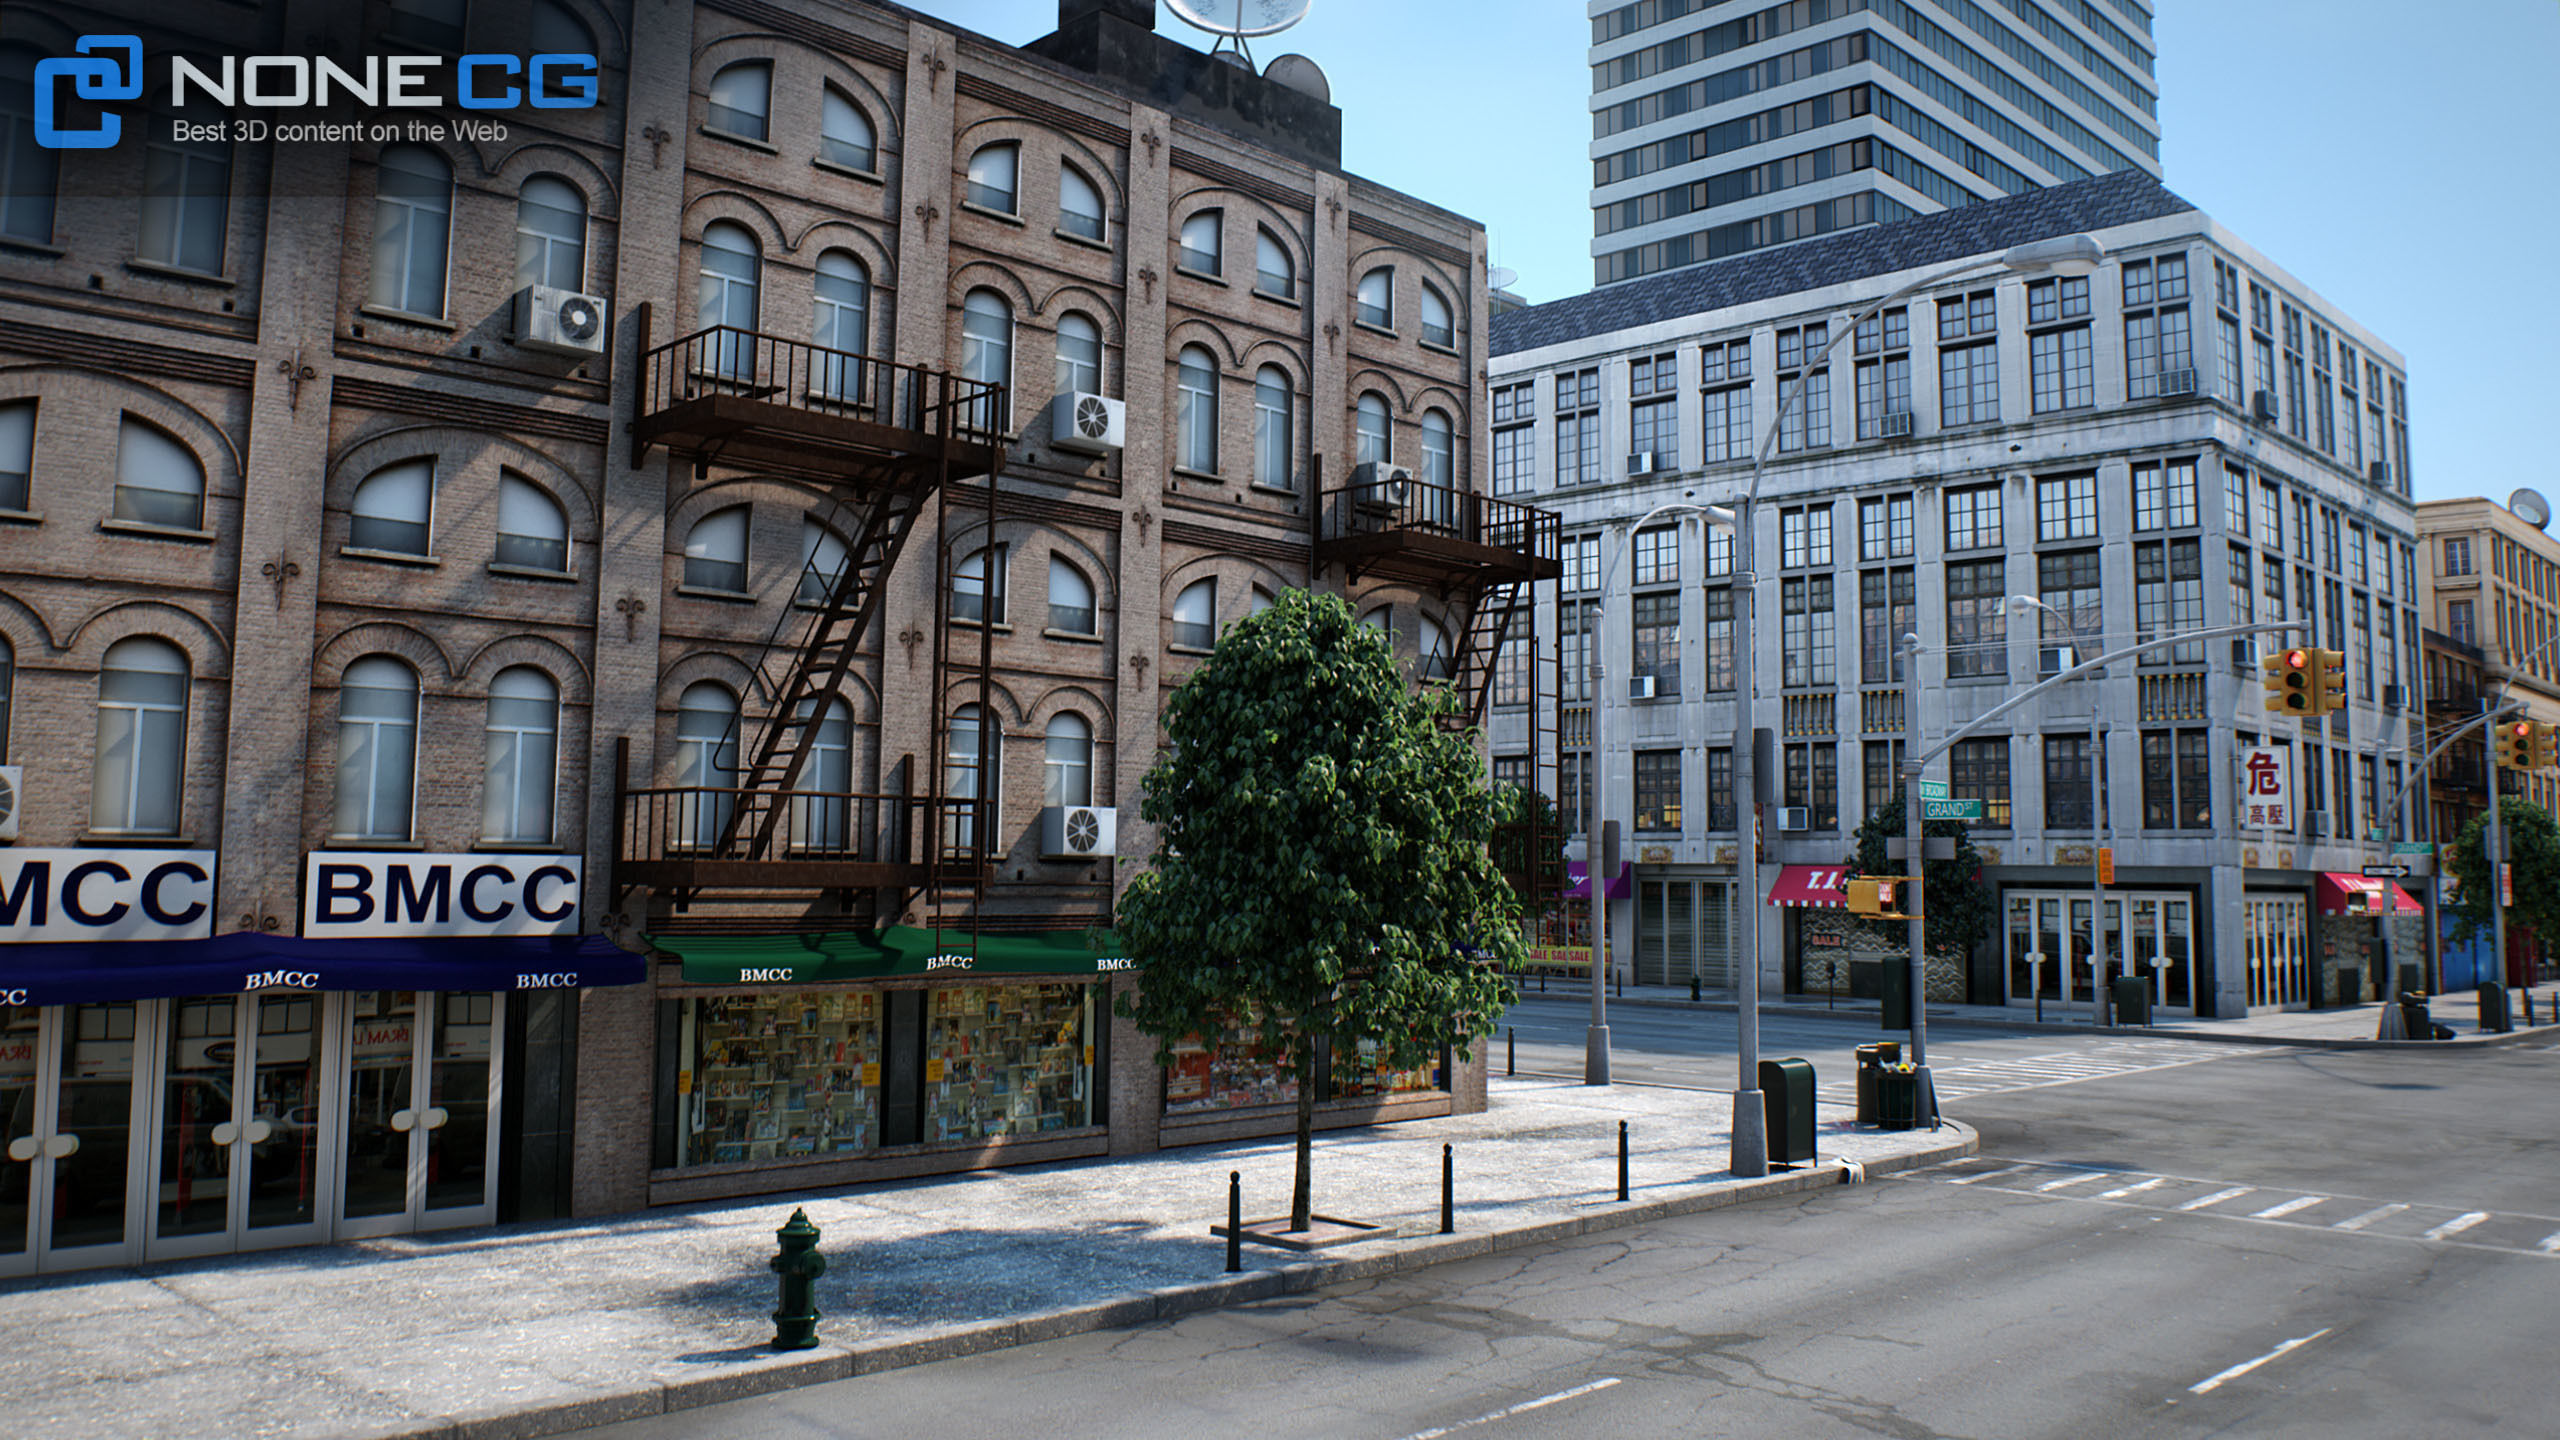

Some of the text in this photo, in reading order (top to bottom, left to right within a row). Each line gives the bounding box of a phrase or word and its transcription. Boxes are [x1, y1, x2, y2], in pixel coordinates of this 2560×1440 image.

[2246, 751, 2281, 796] 危
[1927, 802, 1974, 817] GRAND ST
[0, 860, 209, 927] MCC
[315, 863, 577, 923] BMCC
[926, 954, 974, 970] BMCC
[1569, 950, 1589, 962] SALE
[245, 969, 320, 990] BMCC
[516, 972, 577, 989] BMCC
[740, 968, 793, 982] BMCC
